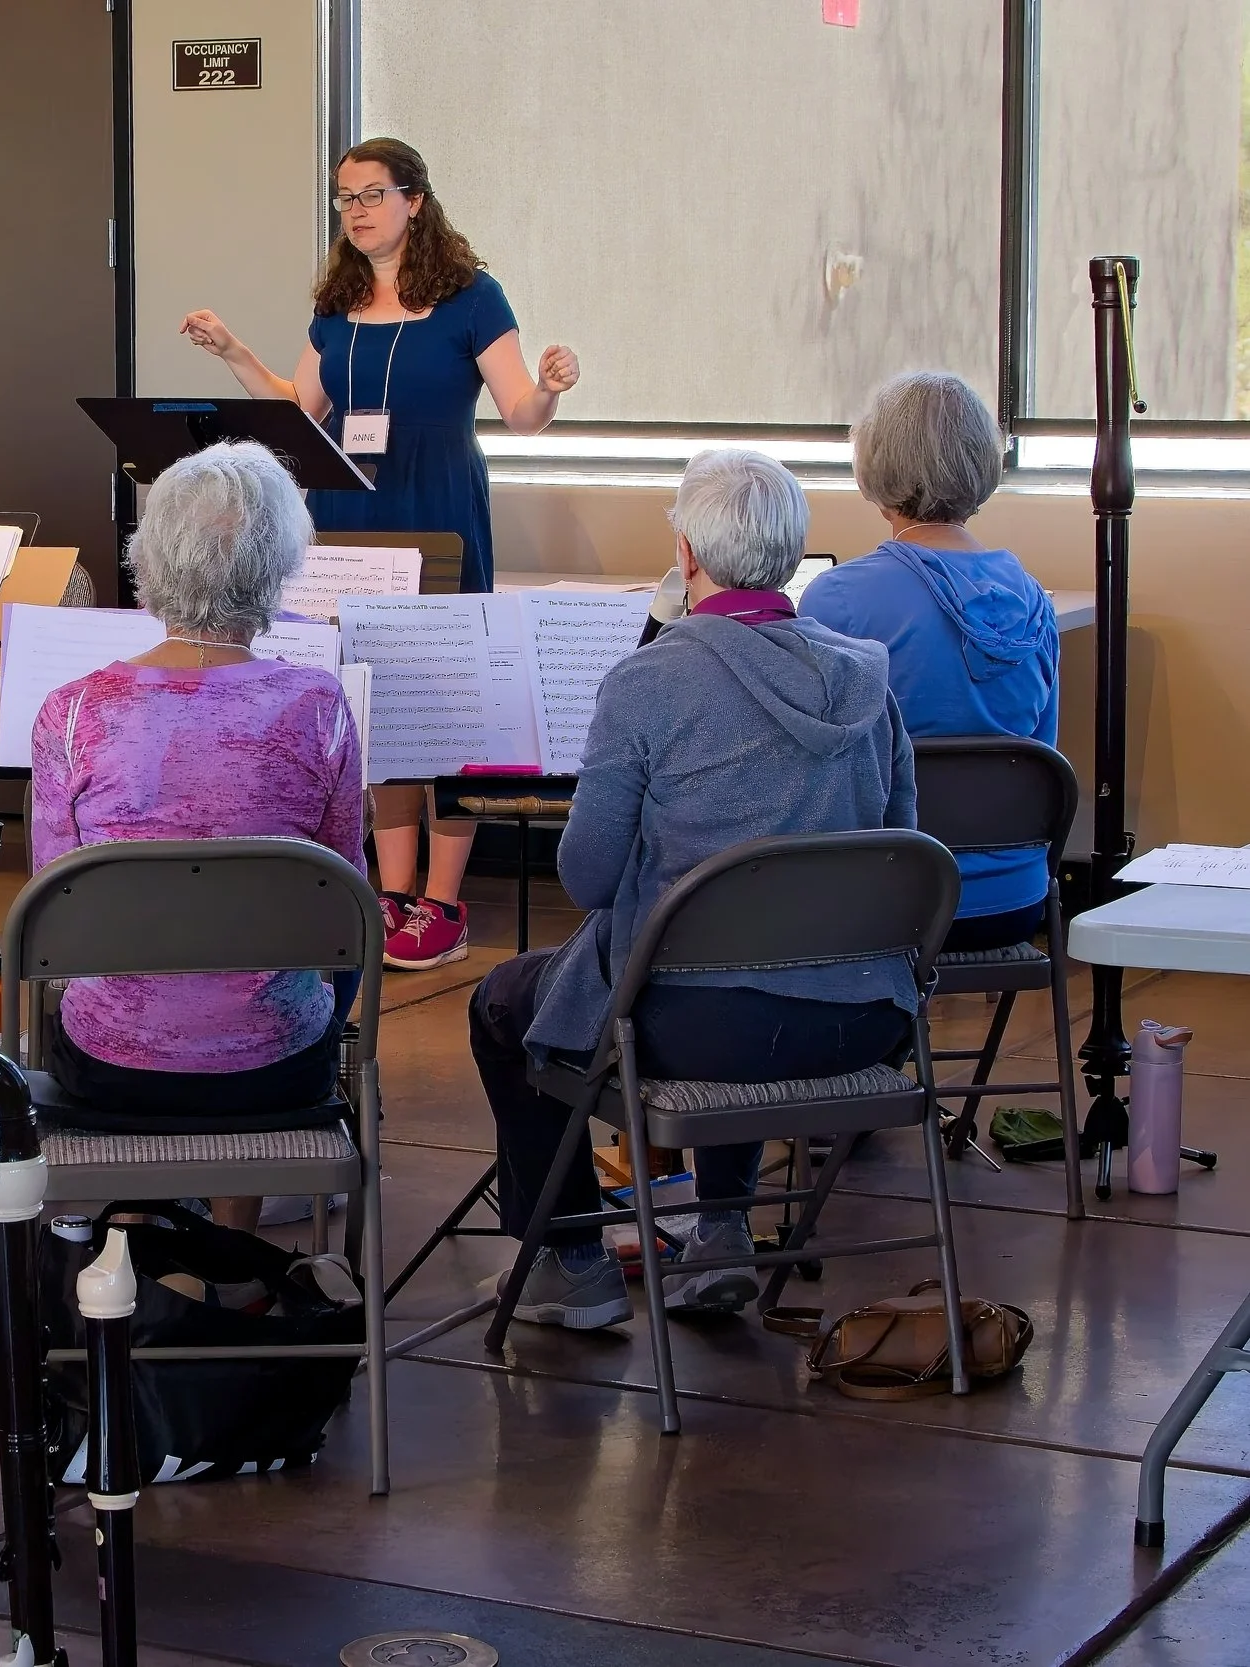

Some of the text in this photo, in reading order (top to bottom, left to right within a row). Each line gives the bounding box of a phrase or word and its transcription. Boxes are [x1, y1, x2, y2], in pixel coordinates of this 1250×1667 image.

[184, 44, 249, 56] OCCUPANCY
[203, 57, 230, 68] LIMIT
[198, 70, 236, 85] 222
[352, 433, 376, 442] ANNE
